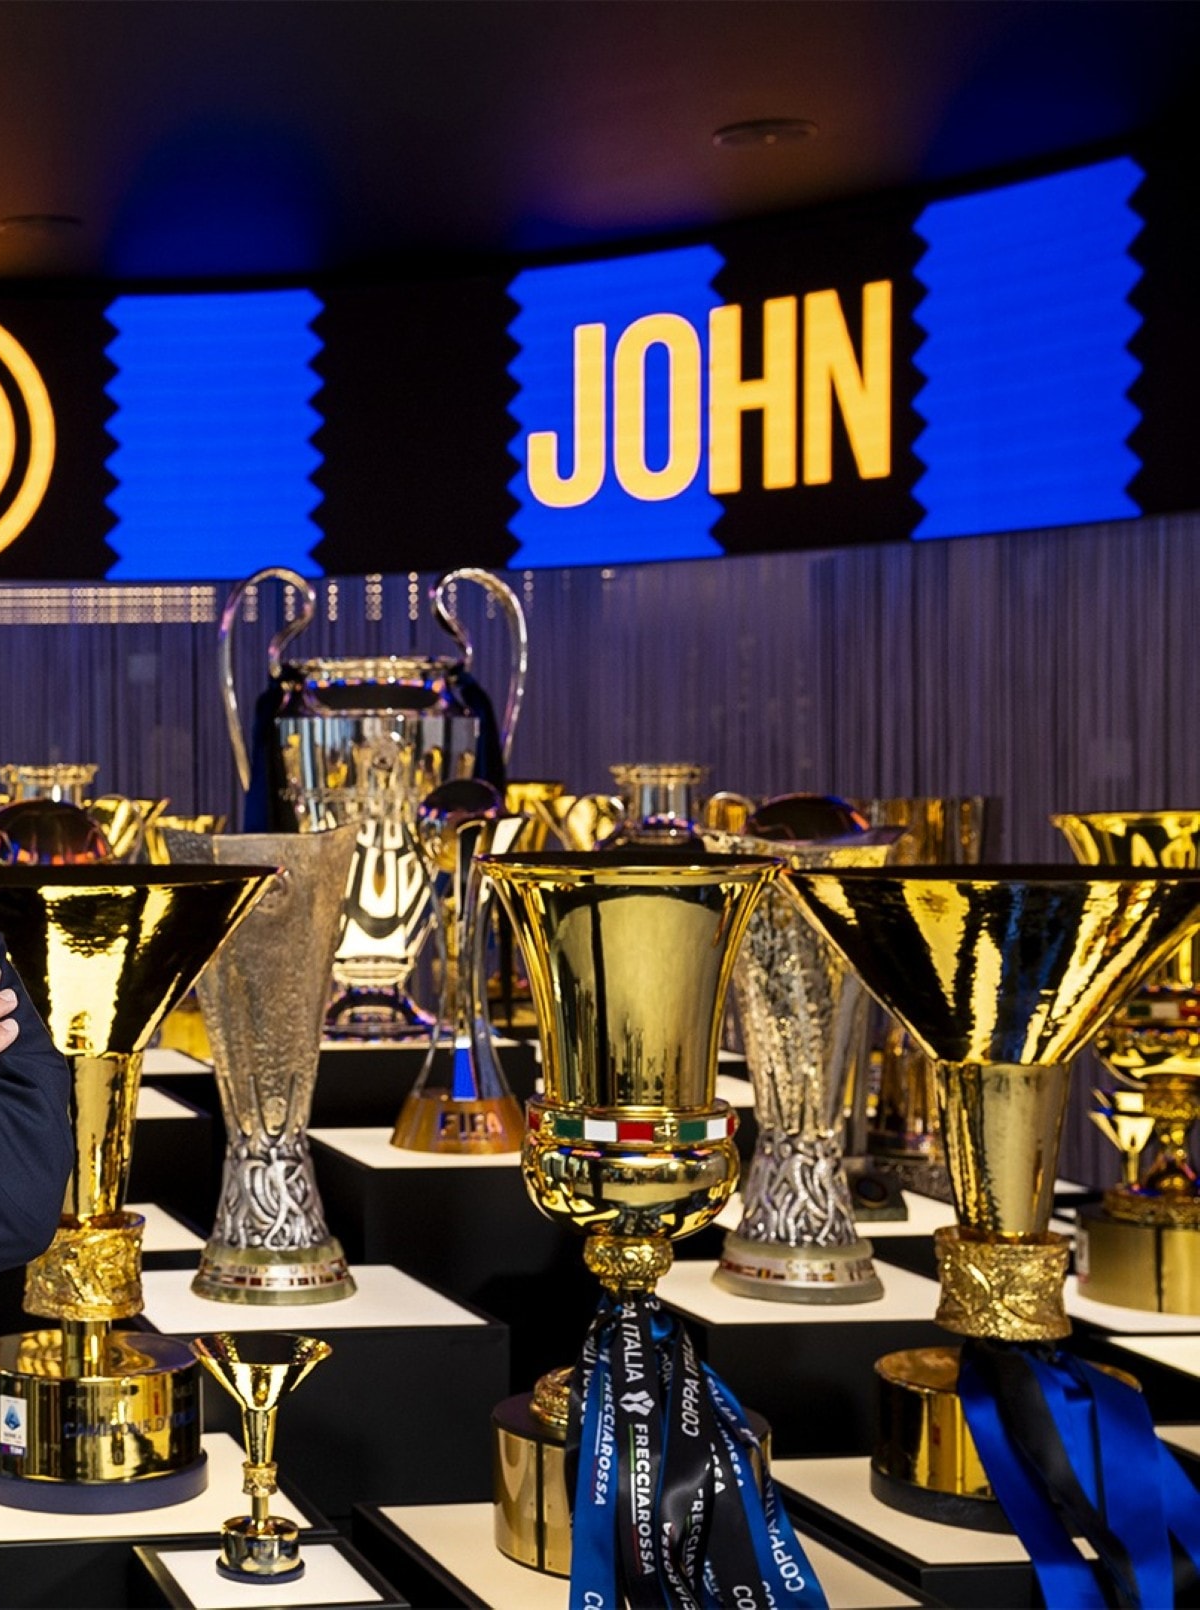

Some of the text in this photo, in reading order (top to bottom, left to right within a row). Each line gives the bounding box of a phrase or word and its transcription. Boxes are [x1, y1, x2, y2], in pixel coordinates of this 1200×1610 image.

[527, 279, 892, 508] JOHN
[621, 1323, 645, 1383] ITALIA
[681, 1378, 700, 1438] COPPA
[634, 1423, 656, 1576] FRECCIAROSSA
